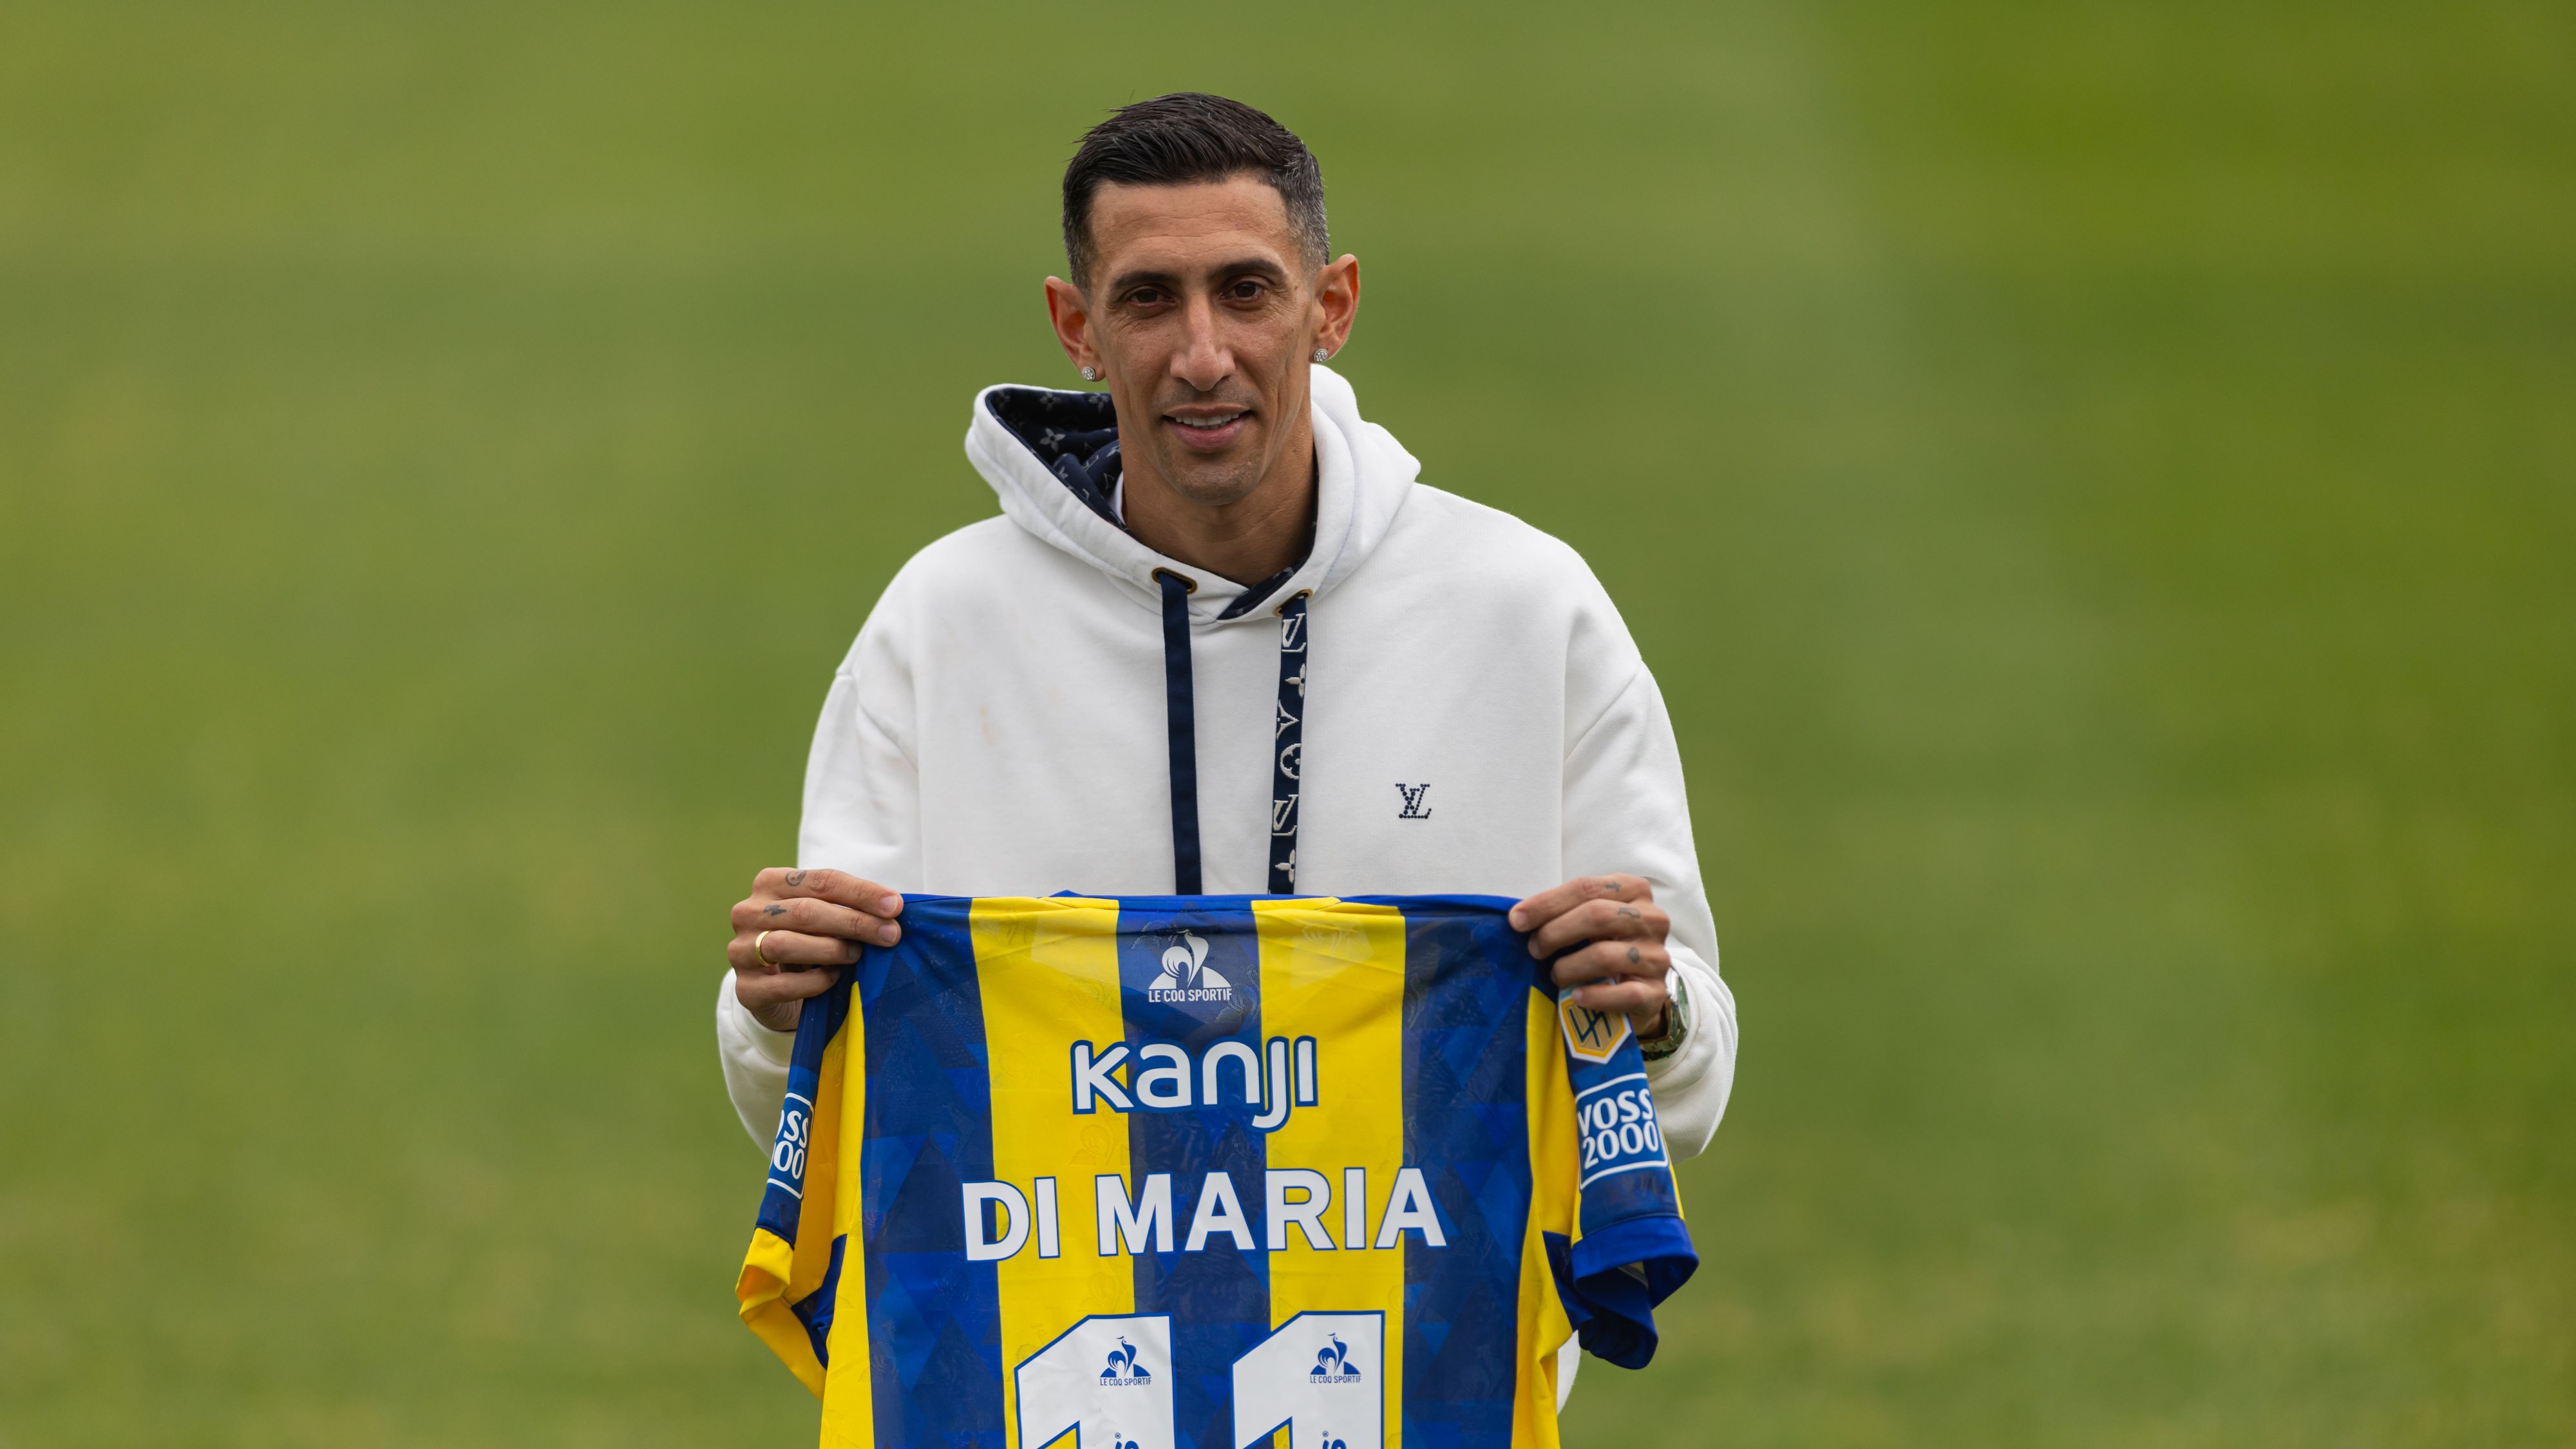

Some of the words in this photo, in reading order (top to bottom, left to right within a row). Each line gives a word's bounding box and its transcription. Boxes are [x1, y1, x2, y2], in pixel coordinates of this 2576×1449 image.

[1148, 990, 1161, 1003] LE
[1163, 989, 1186, 1002] COQ
[1188, 988, 1233, 1001] SPORTIF
[1577, 1088, 1654, 1137] VOSS
[1582, 1121, 1660, 1170] 2000
[960, 1176, 1061, 1262] DI
[1095, 1167, 1447, 1257] MARIA
[1124, 1377, 1152, 1386] SPORTIF
[1334, 1375, 1361, 1383] SPORTIF
